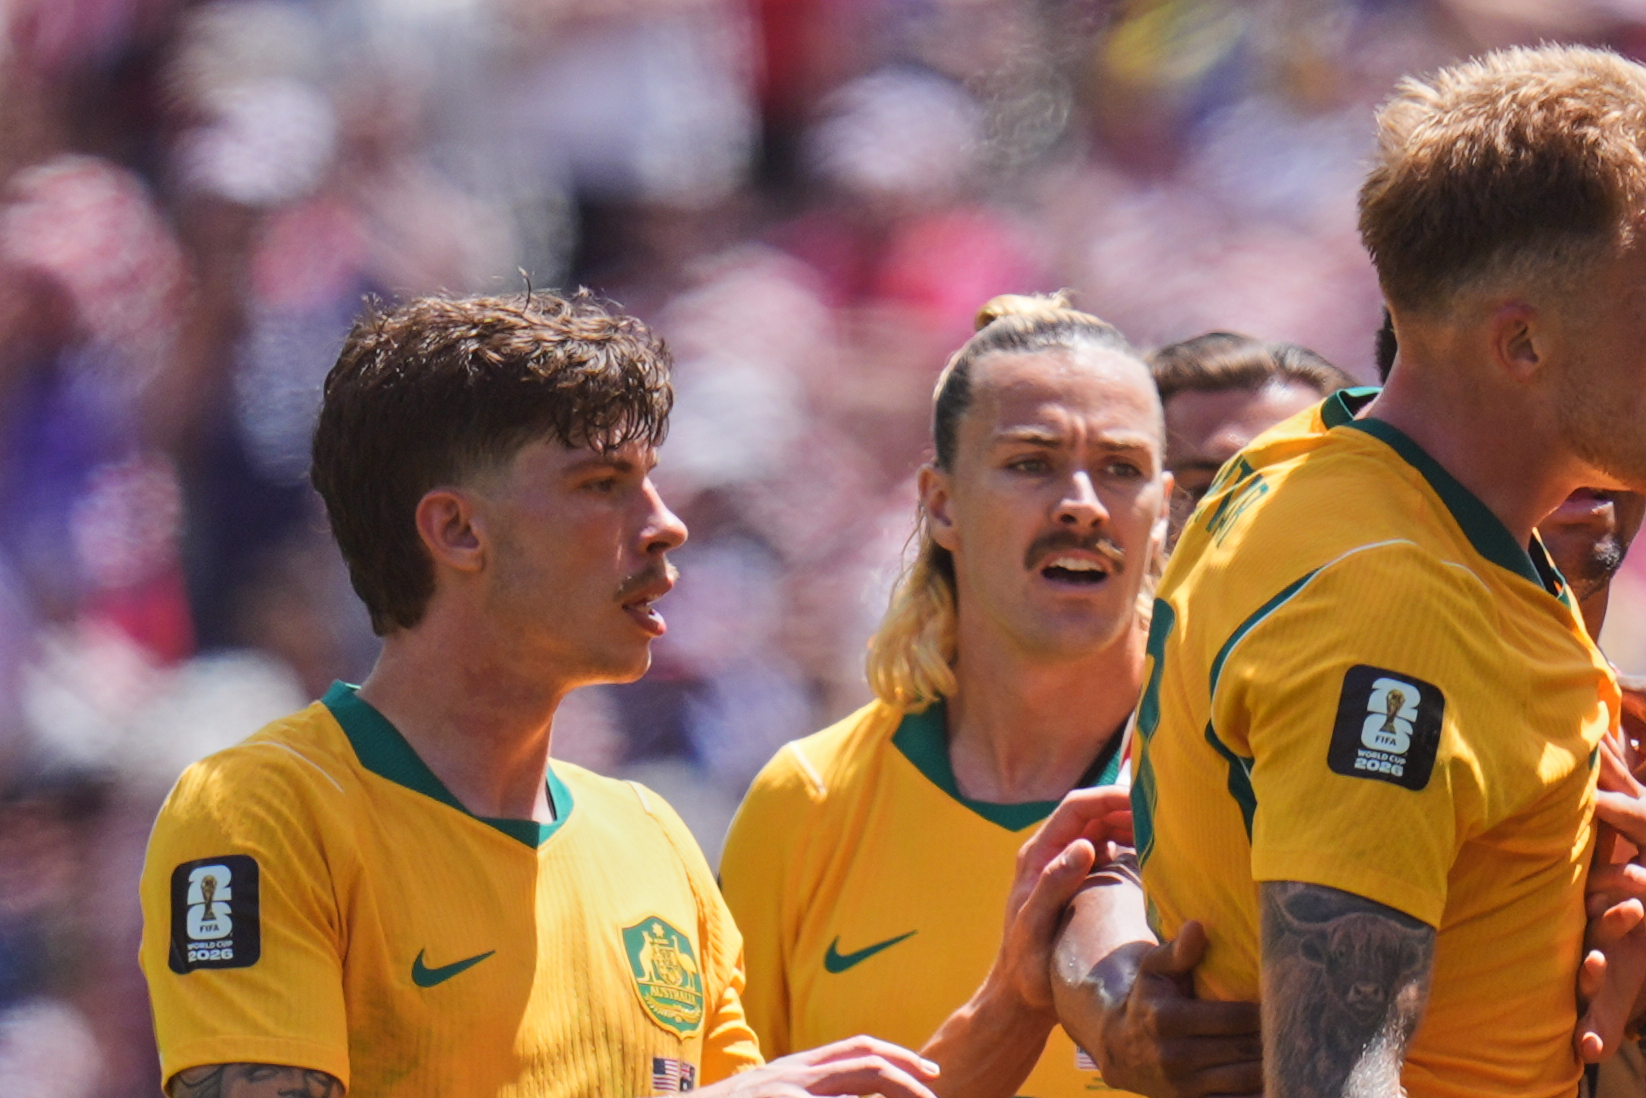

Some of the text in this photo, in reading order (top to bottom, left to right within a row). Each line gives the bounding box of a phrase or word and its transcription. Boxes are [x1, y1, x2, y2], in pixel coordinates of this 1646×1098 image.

[1375, 735, 1396, 746] FIFA
[1357, 749, 1407, 765] WORLD CUP
[1354, 758, 1404, 777] 2026
[200, 924, 219, 933] FIFA
[187, 940, 233, 951] WORLD CUP
[188, 948, 234, 963] 2026
[650, 985, 696, 1004] AUSTRALIA
